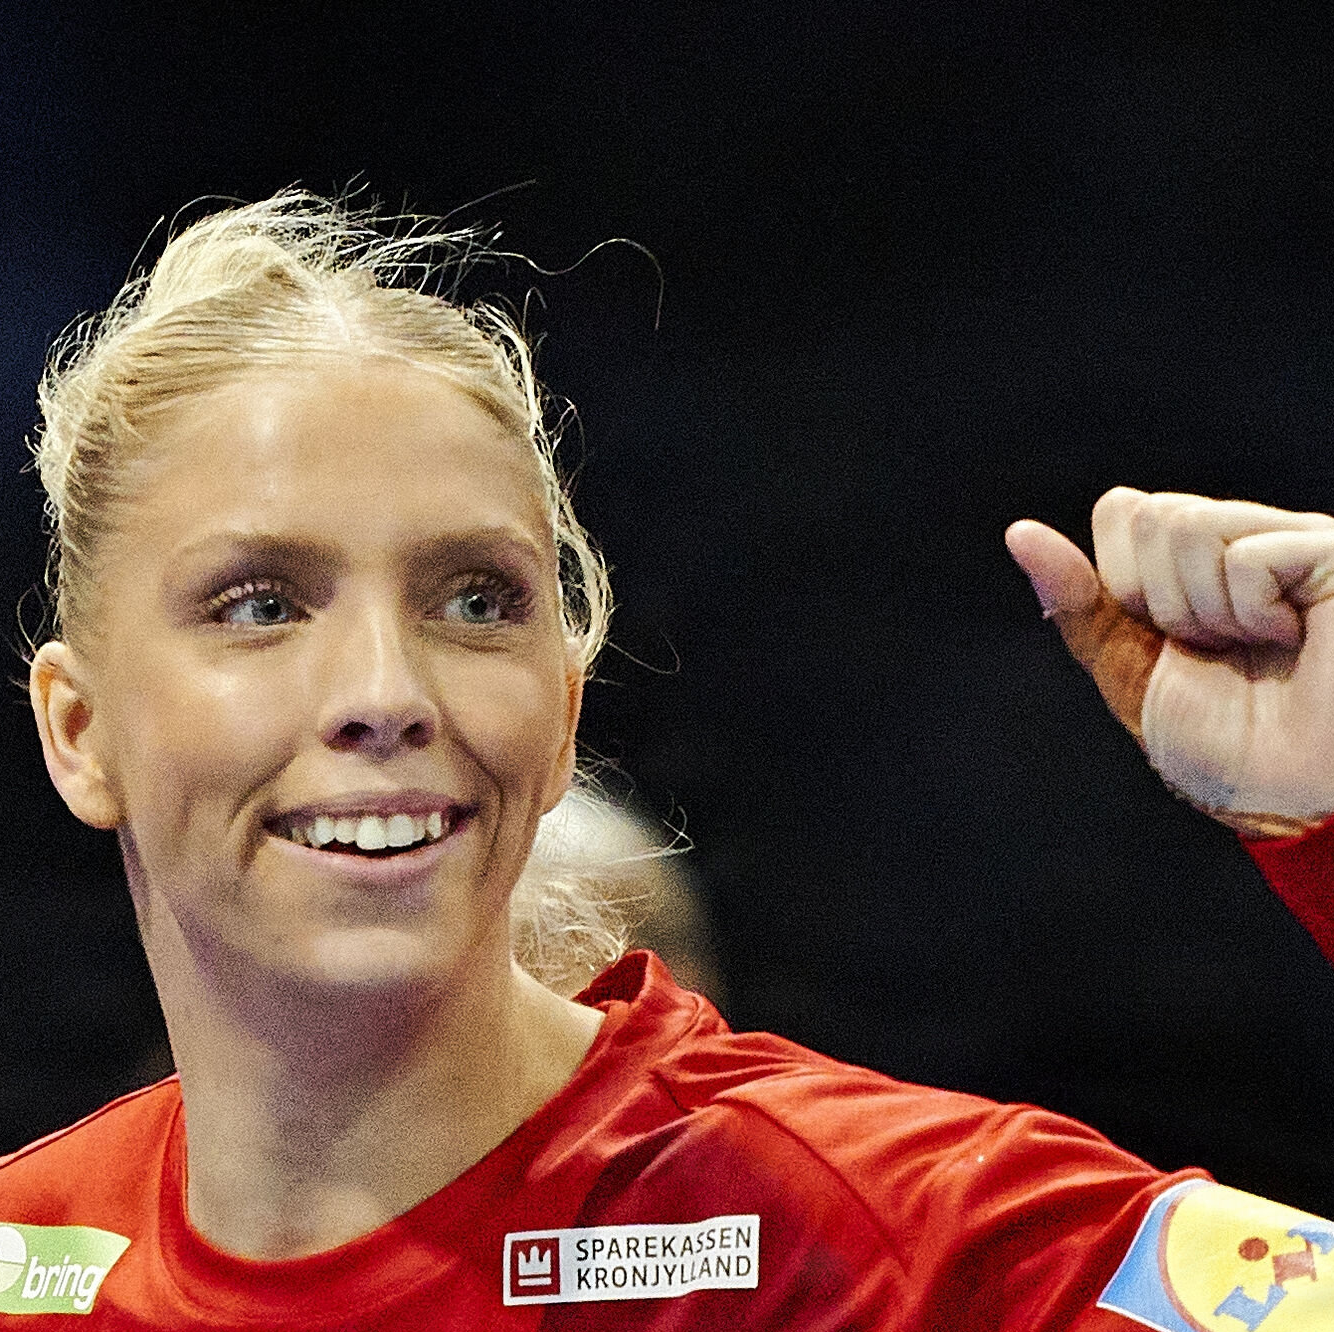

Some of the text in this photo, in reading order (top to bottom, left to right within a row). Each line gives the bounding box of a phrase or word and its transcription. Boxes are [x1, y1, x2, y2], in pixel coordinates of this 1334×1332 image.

[575, 1226, 752, 1262] SPAREKASSEN
[21, 1255, 107, 1311] bring
[576, 1255, 752, 1291] KRONJYLLAND
